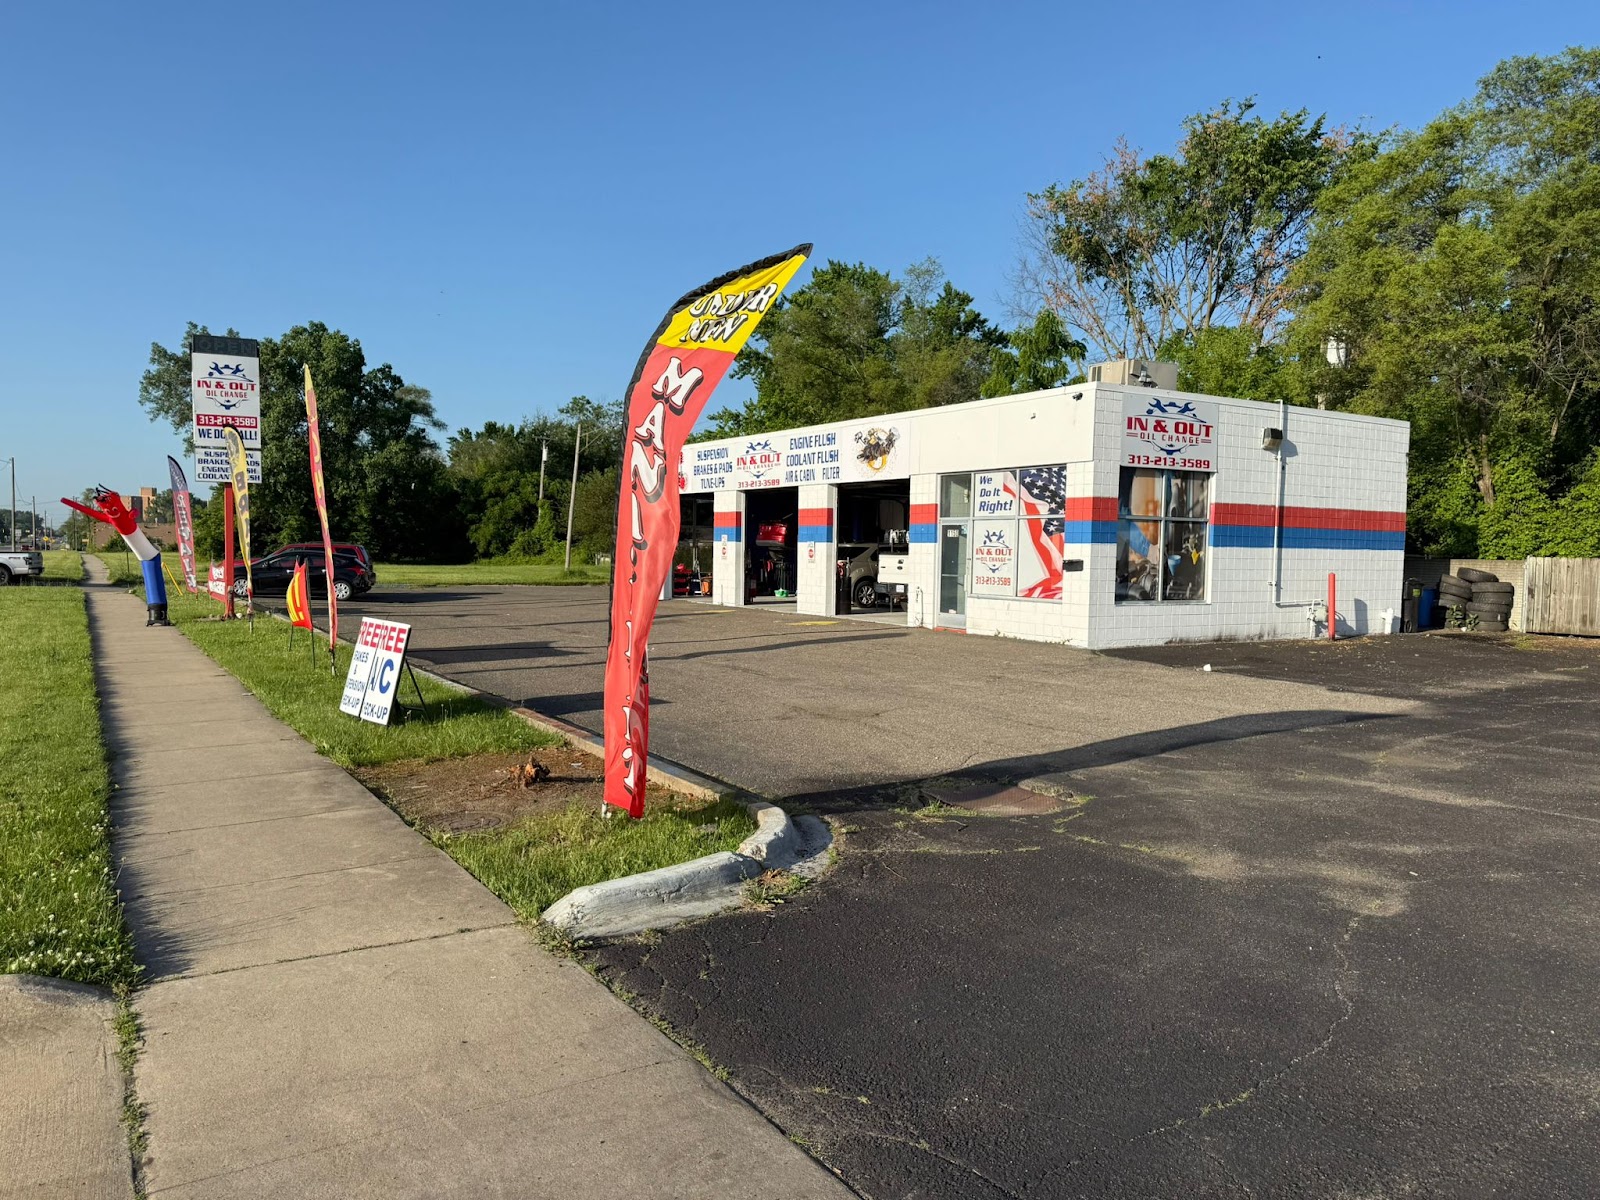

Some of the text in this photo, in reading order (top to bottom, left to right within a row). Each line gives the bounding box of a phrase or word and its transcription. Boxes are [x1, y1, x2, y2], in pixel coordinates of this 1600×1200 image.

[197, 380, 256, 391] IN & OUT
[206, 389, 248, 398] OIL CHANGE
[198, 428, 212, 438] WE
[1126, 416, 1213, 438] IN & OUT
[790, 432, 836, 450] ENGINE FLUSH
[1140, 432, 1199, 445] OIL CHANGE
[697, 447, 729, 461] SUSPENSION
[737, 453, 782, 466] IN & OUT
[786, 449, 839, 467] COOLANT FLUSH
[694, 461, 732, 475] BRAKES & PADS
[1128, 454, 1210, 469] 313-213-3589
[785, 466, 840, 482] AIR & CABIN FILTER
[980, 475, 992, 484] We
[701, 476, 725, 489] TUNE-UPS
[738, 479, 780, 488] 313-213-3589
[980, 487, 1001, 497] Do It
[979, 500, 1013, 514] Right!
[986, 548, 993, 556] &
[995, 548, 1013, 556] OUT
[975, 575, 1011, 586] 313-213-3589
